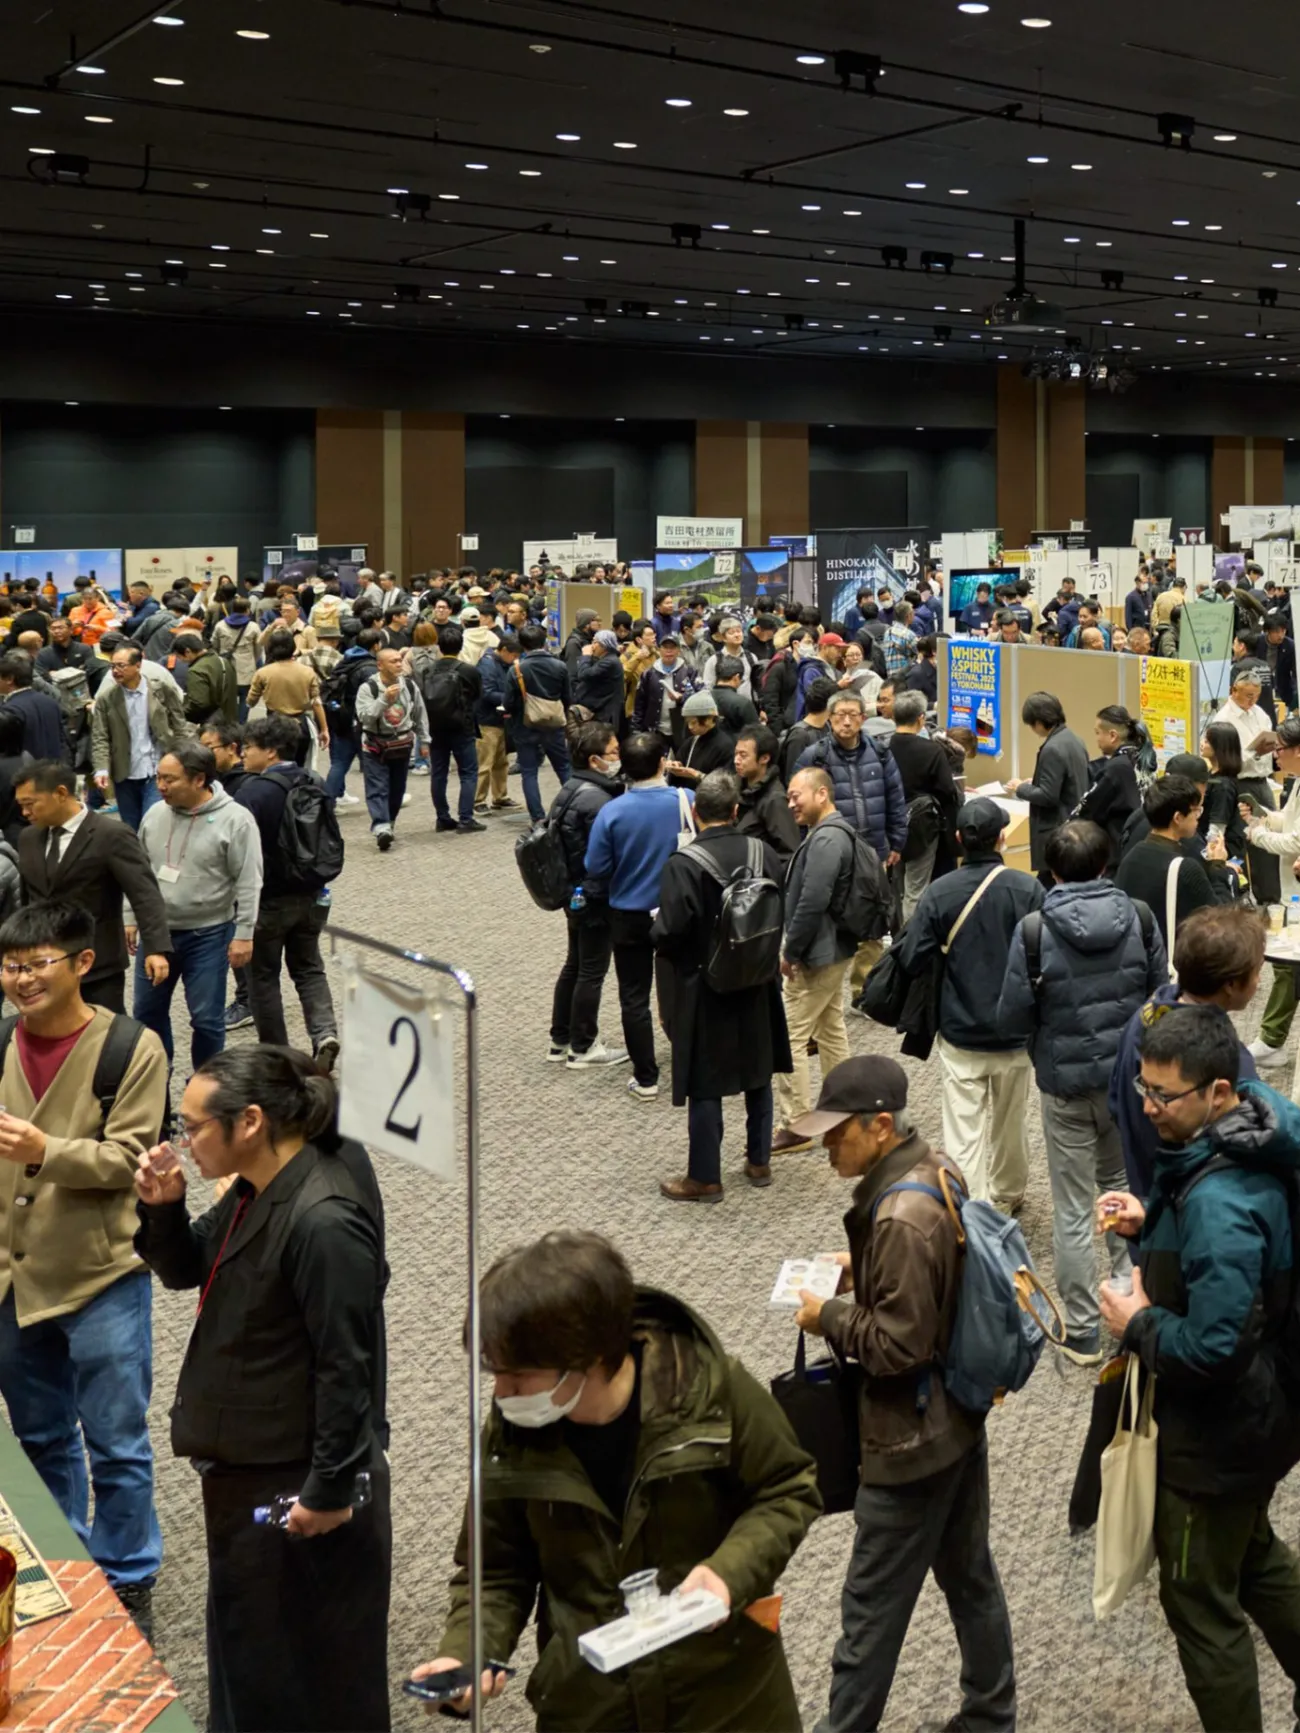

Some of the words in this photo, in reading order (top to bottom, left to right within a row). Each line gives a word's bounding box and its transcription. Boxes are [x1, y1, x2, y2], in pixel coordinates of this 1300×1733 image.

[718, 559, 732, 572] 72
[826, 558, 880, 569] HINOKAMI
[1090, 573, 1107, 590] 73
[1280, 568, 1298, 583] 74
[952, 646, 995, 661] WHISKY
[384, 1016, 422, 1144] 2
